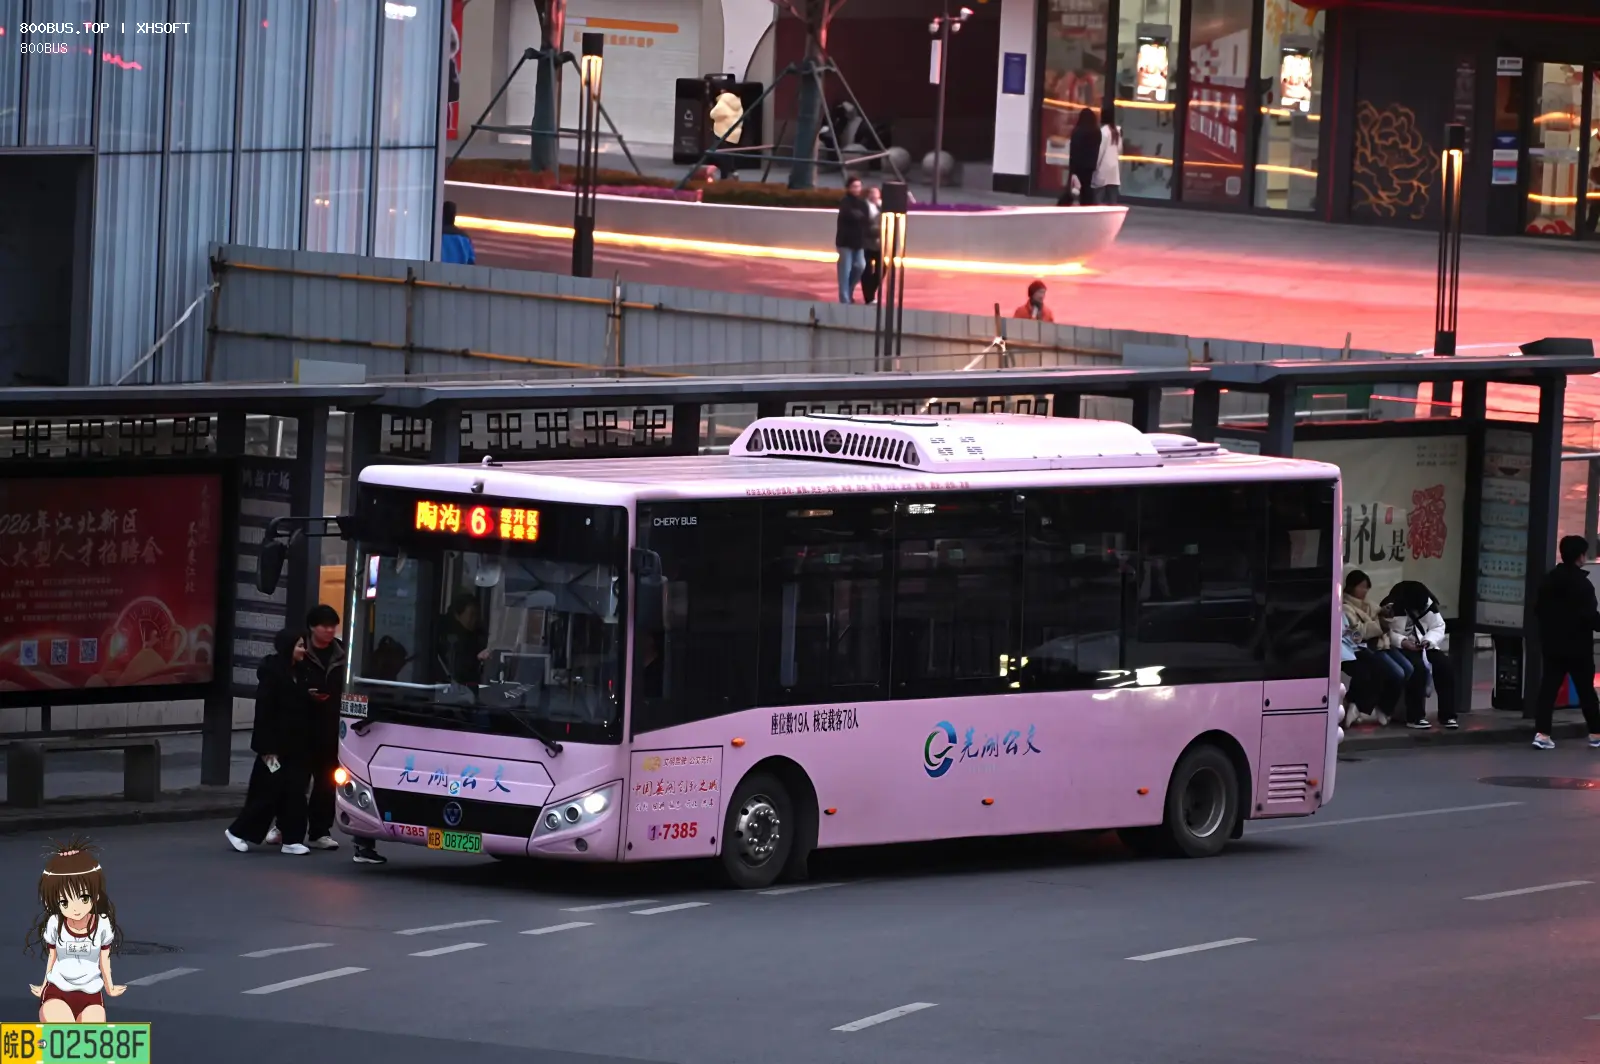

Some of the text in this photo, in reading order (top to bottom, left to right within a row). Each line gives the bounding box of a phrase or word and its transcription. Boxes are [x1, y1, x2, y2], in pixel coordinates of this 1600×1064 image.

[0, 507, 139, 538] 026年江北新区
[416, 501, 487, 535] 陶沟 6
[653, 516, 698, 527] CHERY BUS
[771, 708, 859, 735] 座位数19人 核定载客78人
[958, 722, 1042, 763] 芜湖公交
[398, 825, 425, 837] 7385
